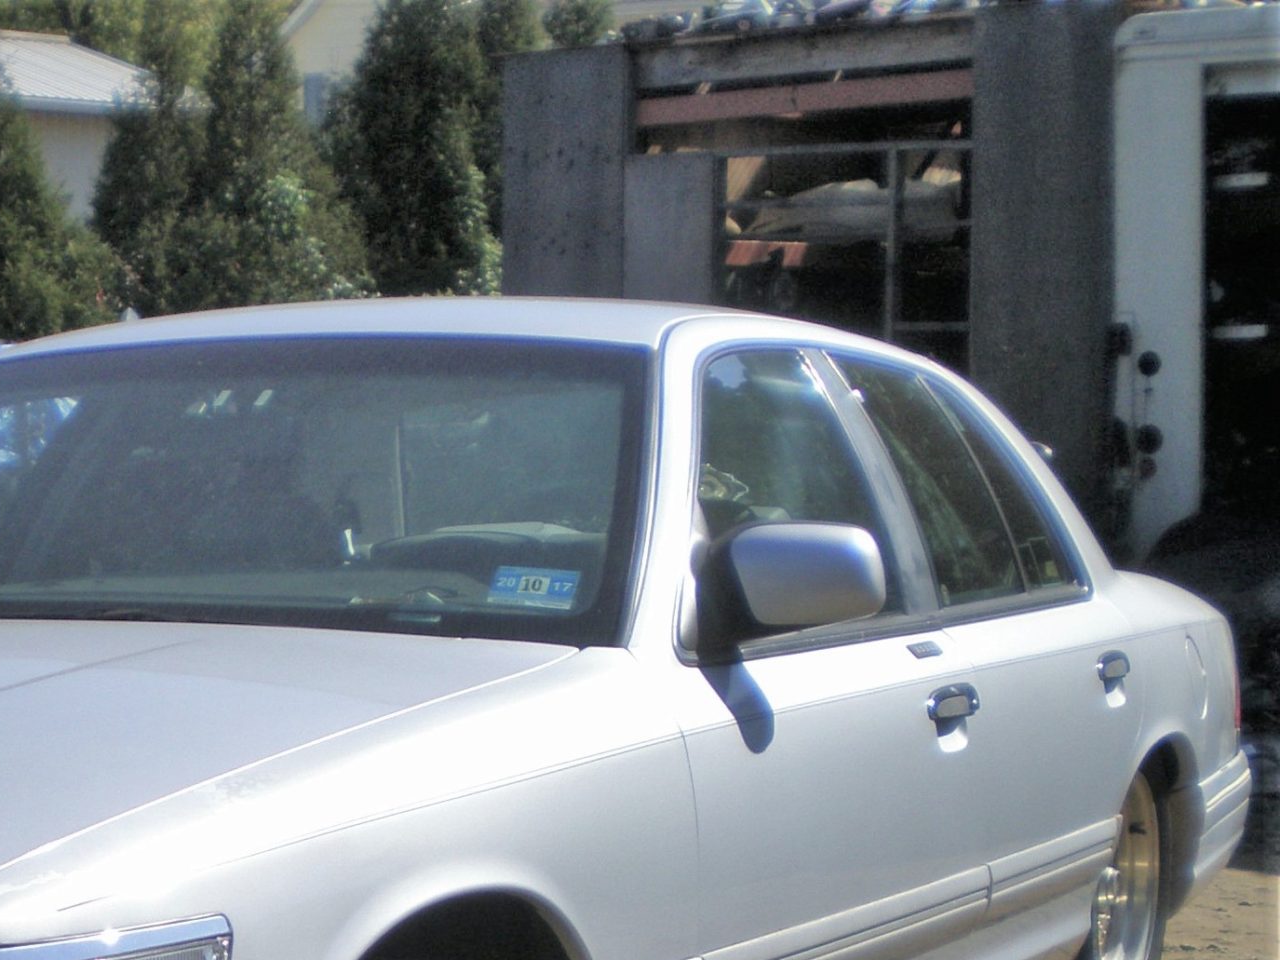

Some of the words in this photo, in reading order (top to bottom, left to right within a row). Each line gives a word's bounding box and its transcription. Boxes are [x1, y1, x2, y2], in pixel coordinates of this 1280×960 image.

[496, 577, 516, 588] 20
[521, 577, 544, 592] 10
[552, 582, 574, 592] 17
